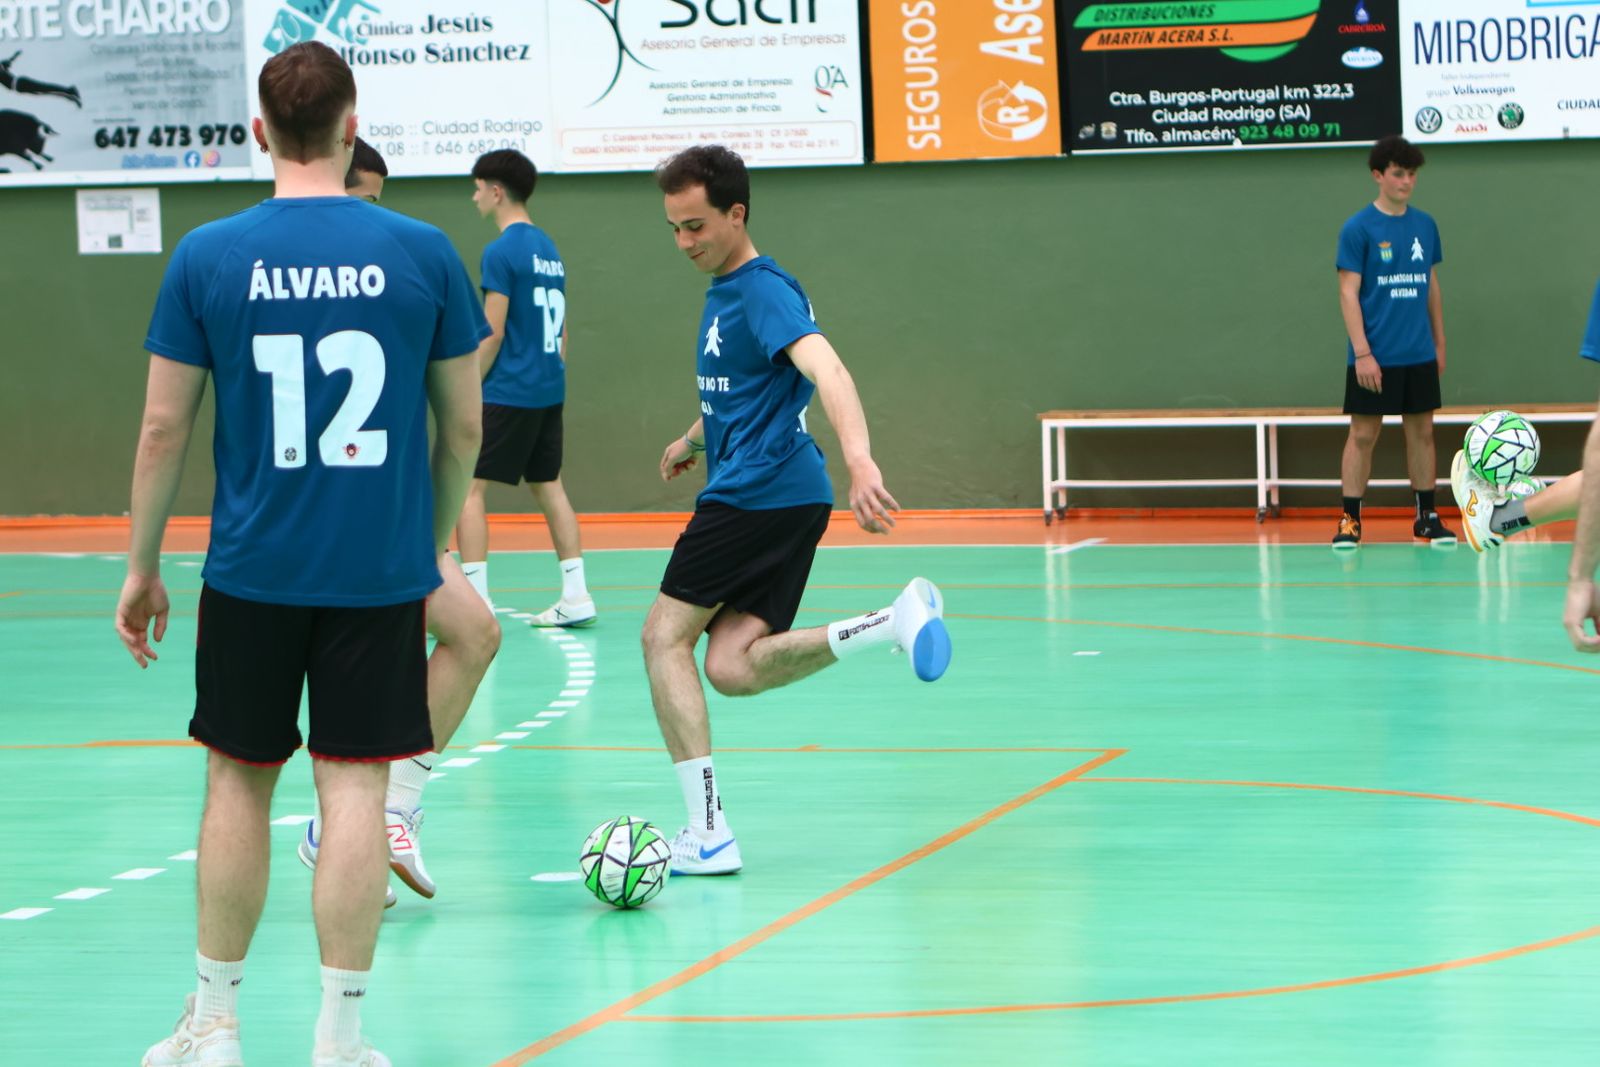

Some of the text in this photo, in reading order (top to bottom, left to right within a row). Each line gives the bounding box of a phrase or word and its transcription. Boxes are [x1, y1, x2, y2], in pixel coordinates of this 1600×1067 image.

[67, 0, 232, 37] CHARRO
[420, 12, 493, 35] Jesús
[1093, 4, 1216, 22] DISTRIBUCIONES
[700, 34, 754, 49] General
[759, 33, 778, 47] de
[782, 31, 848, 48] Empresas
[1157, 29, 1204, 44] ACERA
[1208, 27, 1234, 42] S.L.
[339, 41, 532, 66] lfonso Sánchez
[691, 78, 729, 89] General
[732, 78, 745, 88] de
[901, 0, 942, 150] SEGUROS
[1109, 82, 1354, 107] Ctra. Burgos-Portugal km 322,3
[1453, 83, 1516, 97] Volkswagen
[1152, 103, 1311, 124] Ciudad Rodrigo (SA)
[94, 123, 247, 149] 647 473 970
[369, 119, 543, 138] bajo Ciudad Rodrigo
[1161, 125, 1236, 143] almacén:
[1239, 124, 1269, 140] 923
[1273, 123, 1294, 138] 48
[1299, 122, 1320, 137] 09
[1324, 122, 1341, 137] 71
[386, 142, 405, 157] 08
[435, 141, 463, 155] 646
[468, 139, 497, 154] 682
[249, 259, 385, 300] ÁLVARO
[533, 286, 566, 355] 12
[717, 376, 730, 392] TE
[252, 330, 388, 469] 12
